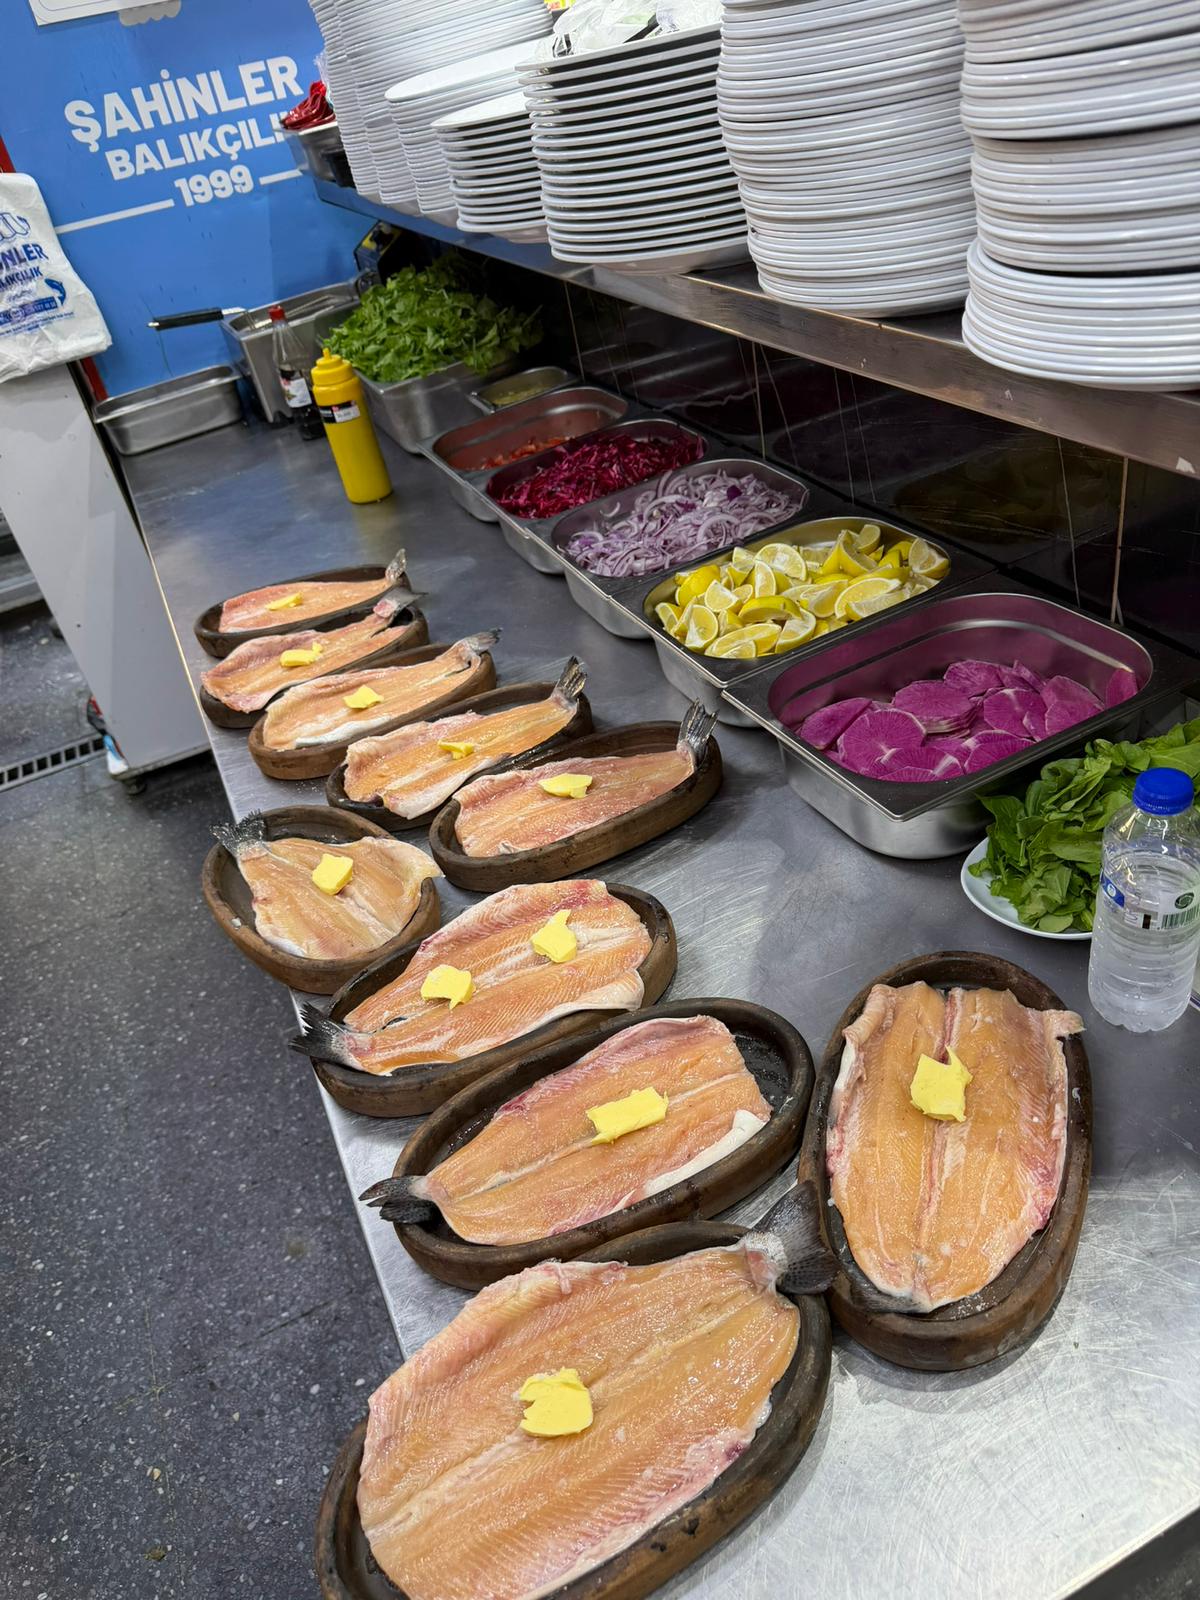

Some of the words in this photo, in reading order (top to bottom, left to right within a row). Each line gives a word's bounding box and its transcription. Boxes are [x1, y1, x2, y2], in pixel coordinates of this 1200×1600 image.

[64, 56, 304, 152] ŞAHİNLER
[105, 111, 288, 181] BALIKÇILI
[174, 164, 254, 207] 1999
